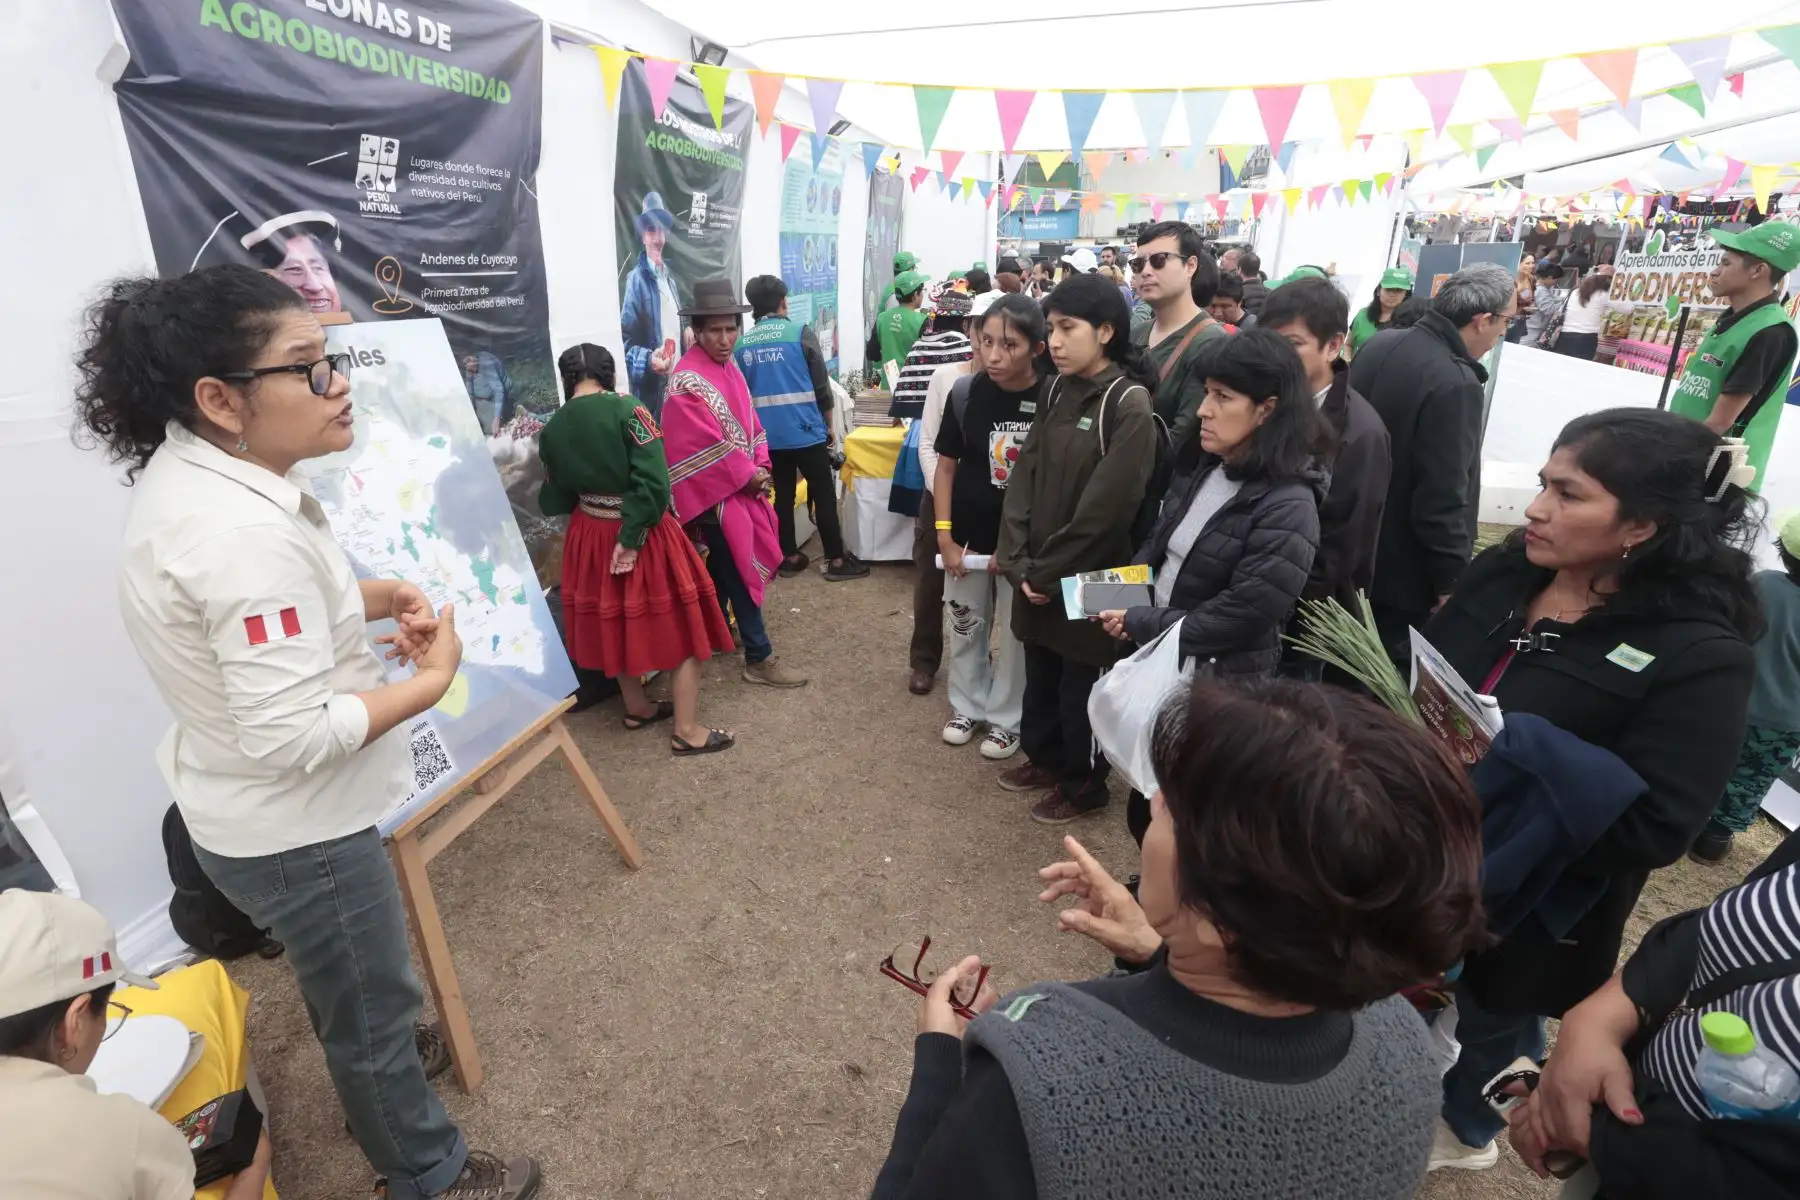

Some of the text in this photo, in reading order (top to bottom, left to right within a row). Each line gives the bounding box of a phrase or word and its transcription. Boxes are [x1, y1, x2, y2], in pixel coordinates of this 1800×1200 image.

[417, 16, 452, 51] DE
[200, 0, 511, 104] AGROBIODIVERSIDAD
[411, 156, 511, 178] Lugares donde florece la
[409, 171, 502, 191] diversidad de cultivos
[367, 190, 391, 203] PERÚ
[411, 188, 446, 200] nativos
[448, 190, 462, 201] del
[360, 202, 402, 215] NATURAL
[420, 253, 518, 267] Andenes de Cuyocuyo
[1618, 249, 1687, 271] Aprendamos
[1691, 246, 1708, 268] de
[421, 285, 490, 300] ¡Primera Zona de
[424, 299, 495, 315] Agrobiodiversidad
[496, 297, 506, 307] del
[757, 351, 785, 363] LIMA
[1420, 703, 1448, 739] Recetario
